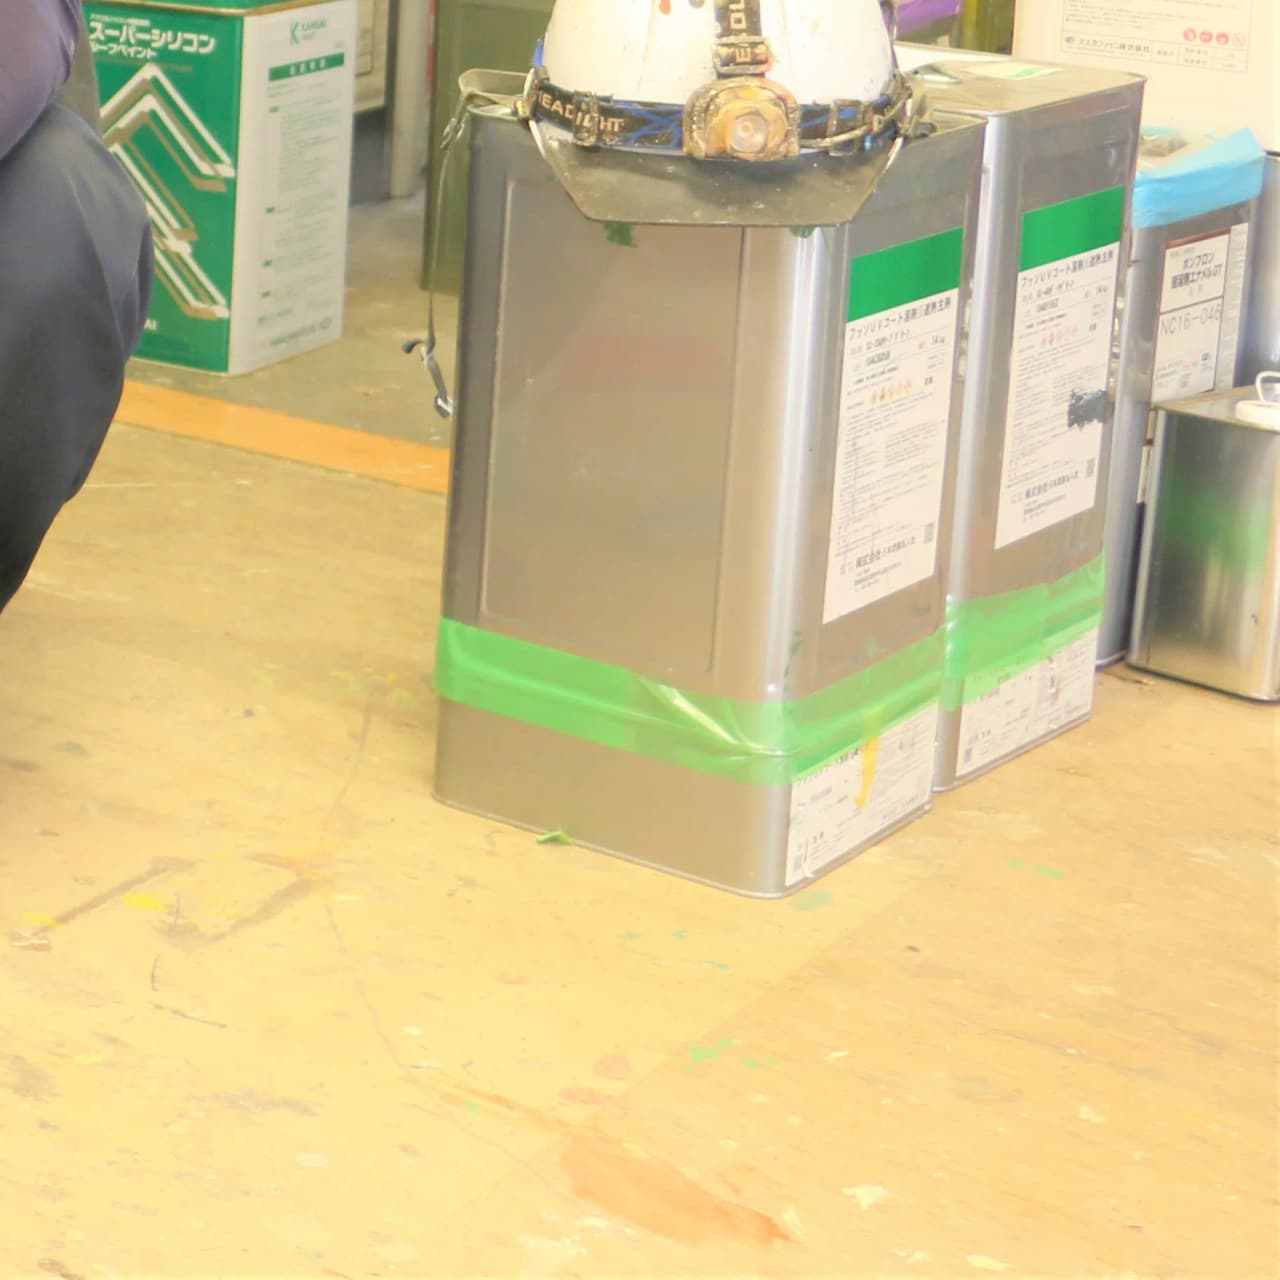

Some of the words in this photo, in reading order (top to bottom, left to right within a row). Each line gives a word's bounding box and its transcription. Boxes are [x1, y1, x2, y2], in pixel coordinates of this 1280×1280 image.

[89, 21, 217, 54] スーパーシリコン
[1182, 252, 1216, 271] ボンフロン
